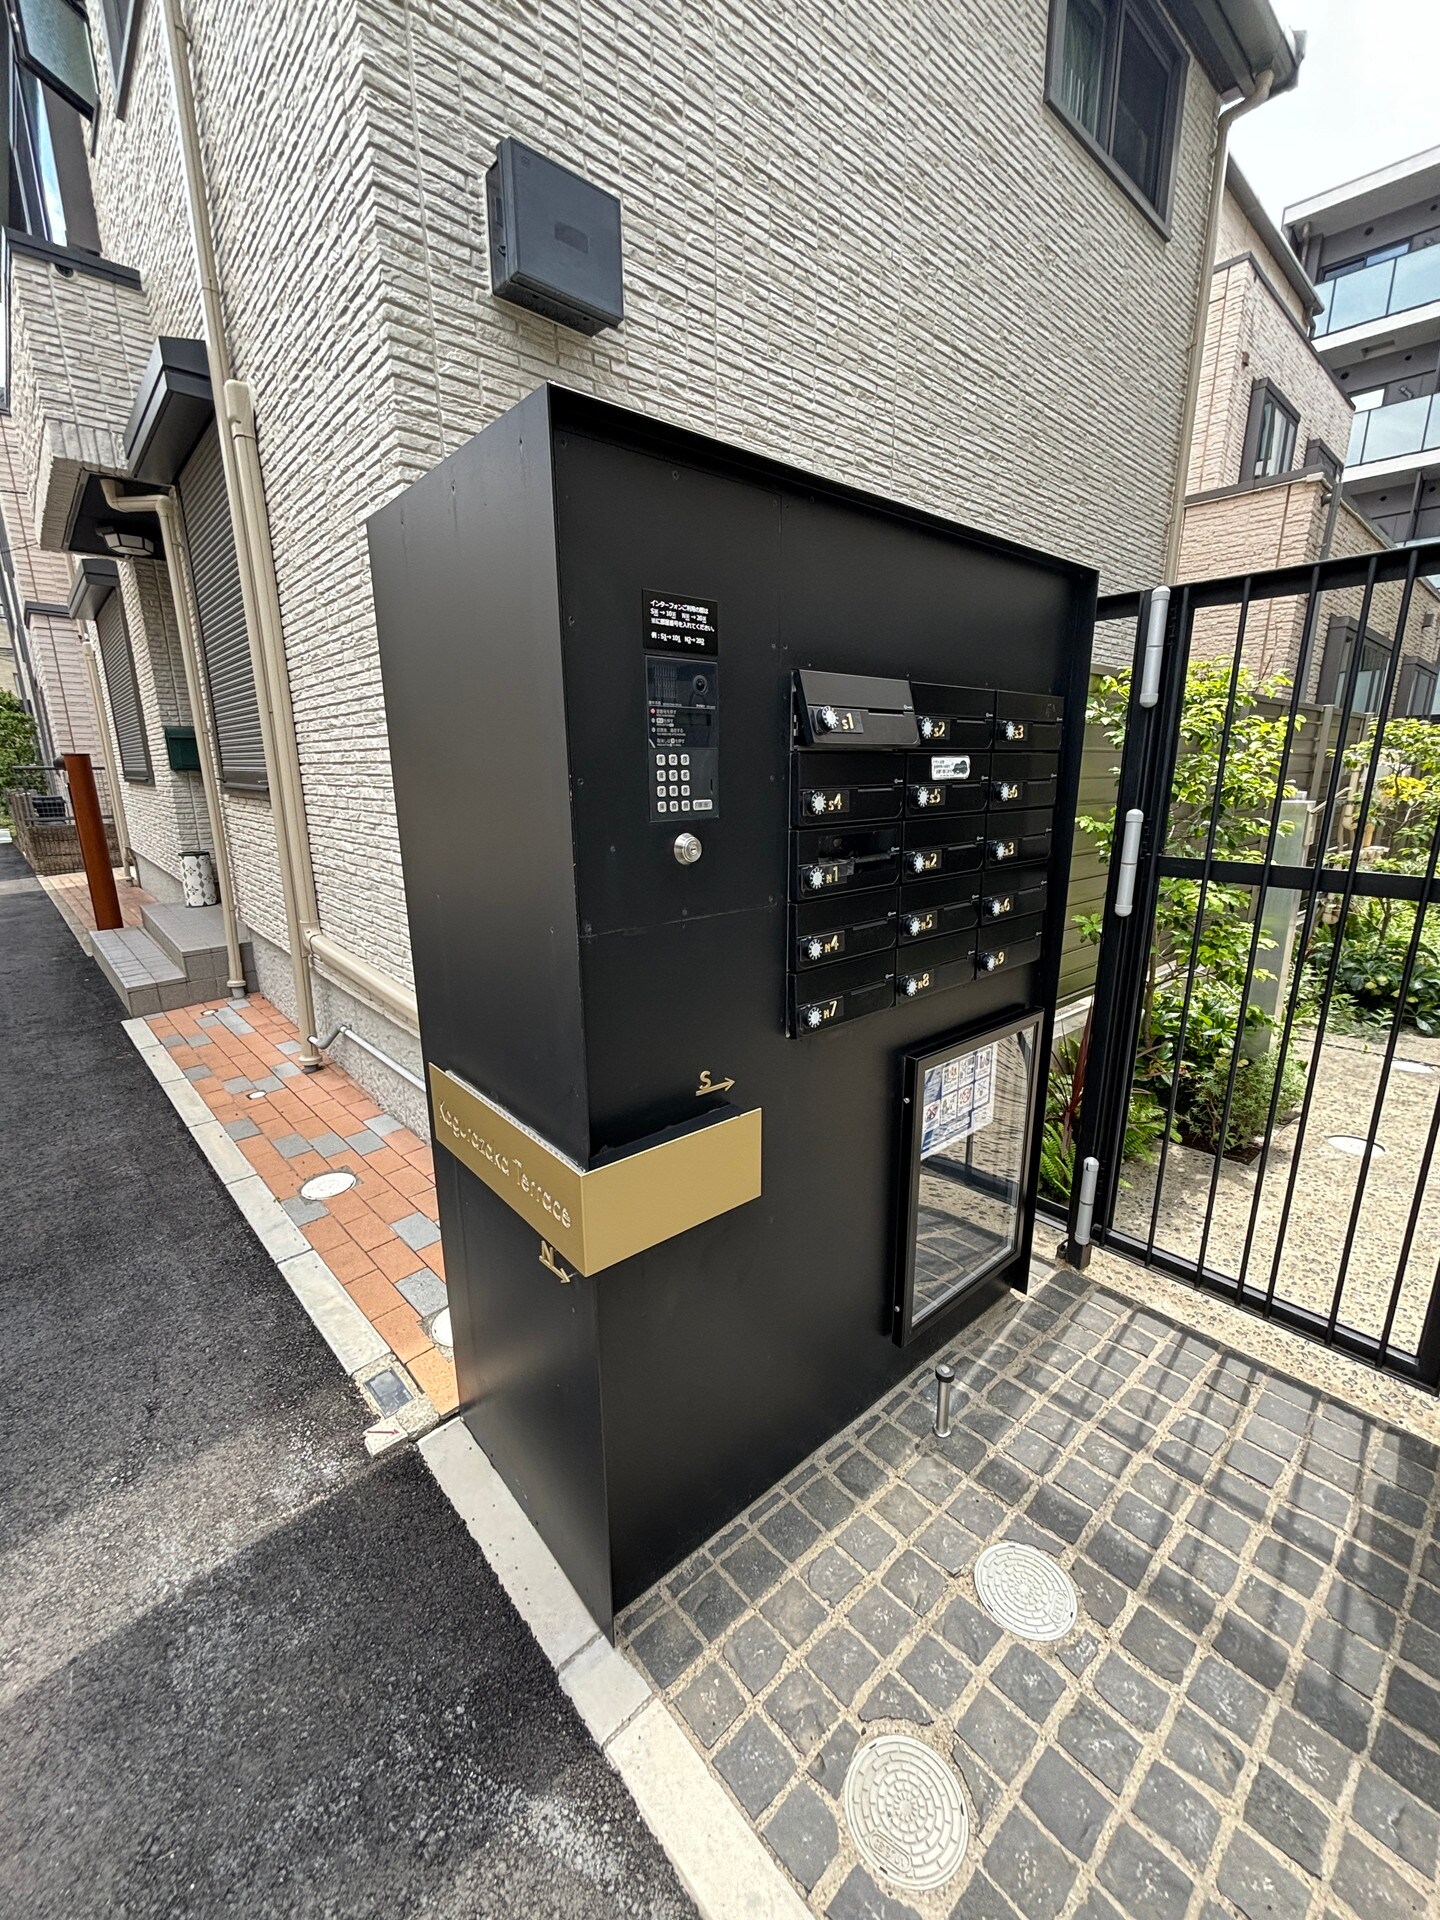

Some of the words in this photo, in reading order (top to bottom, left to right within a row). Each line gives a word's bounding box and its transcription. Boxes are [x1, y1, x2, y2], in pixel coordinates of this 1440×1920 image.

[699, 1070, 712, 1090] S
[512, 1158, 571, 1228] Terrace
[541, 1240, 554, 1267] N
